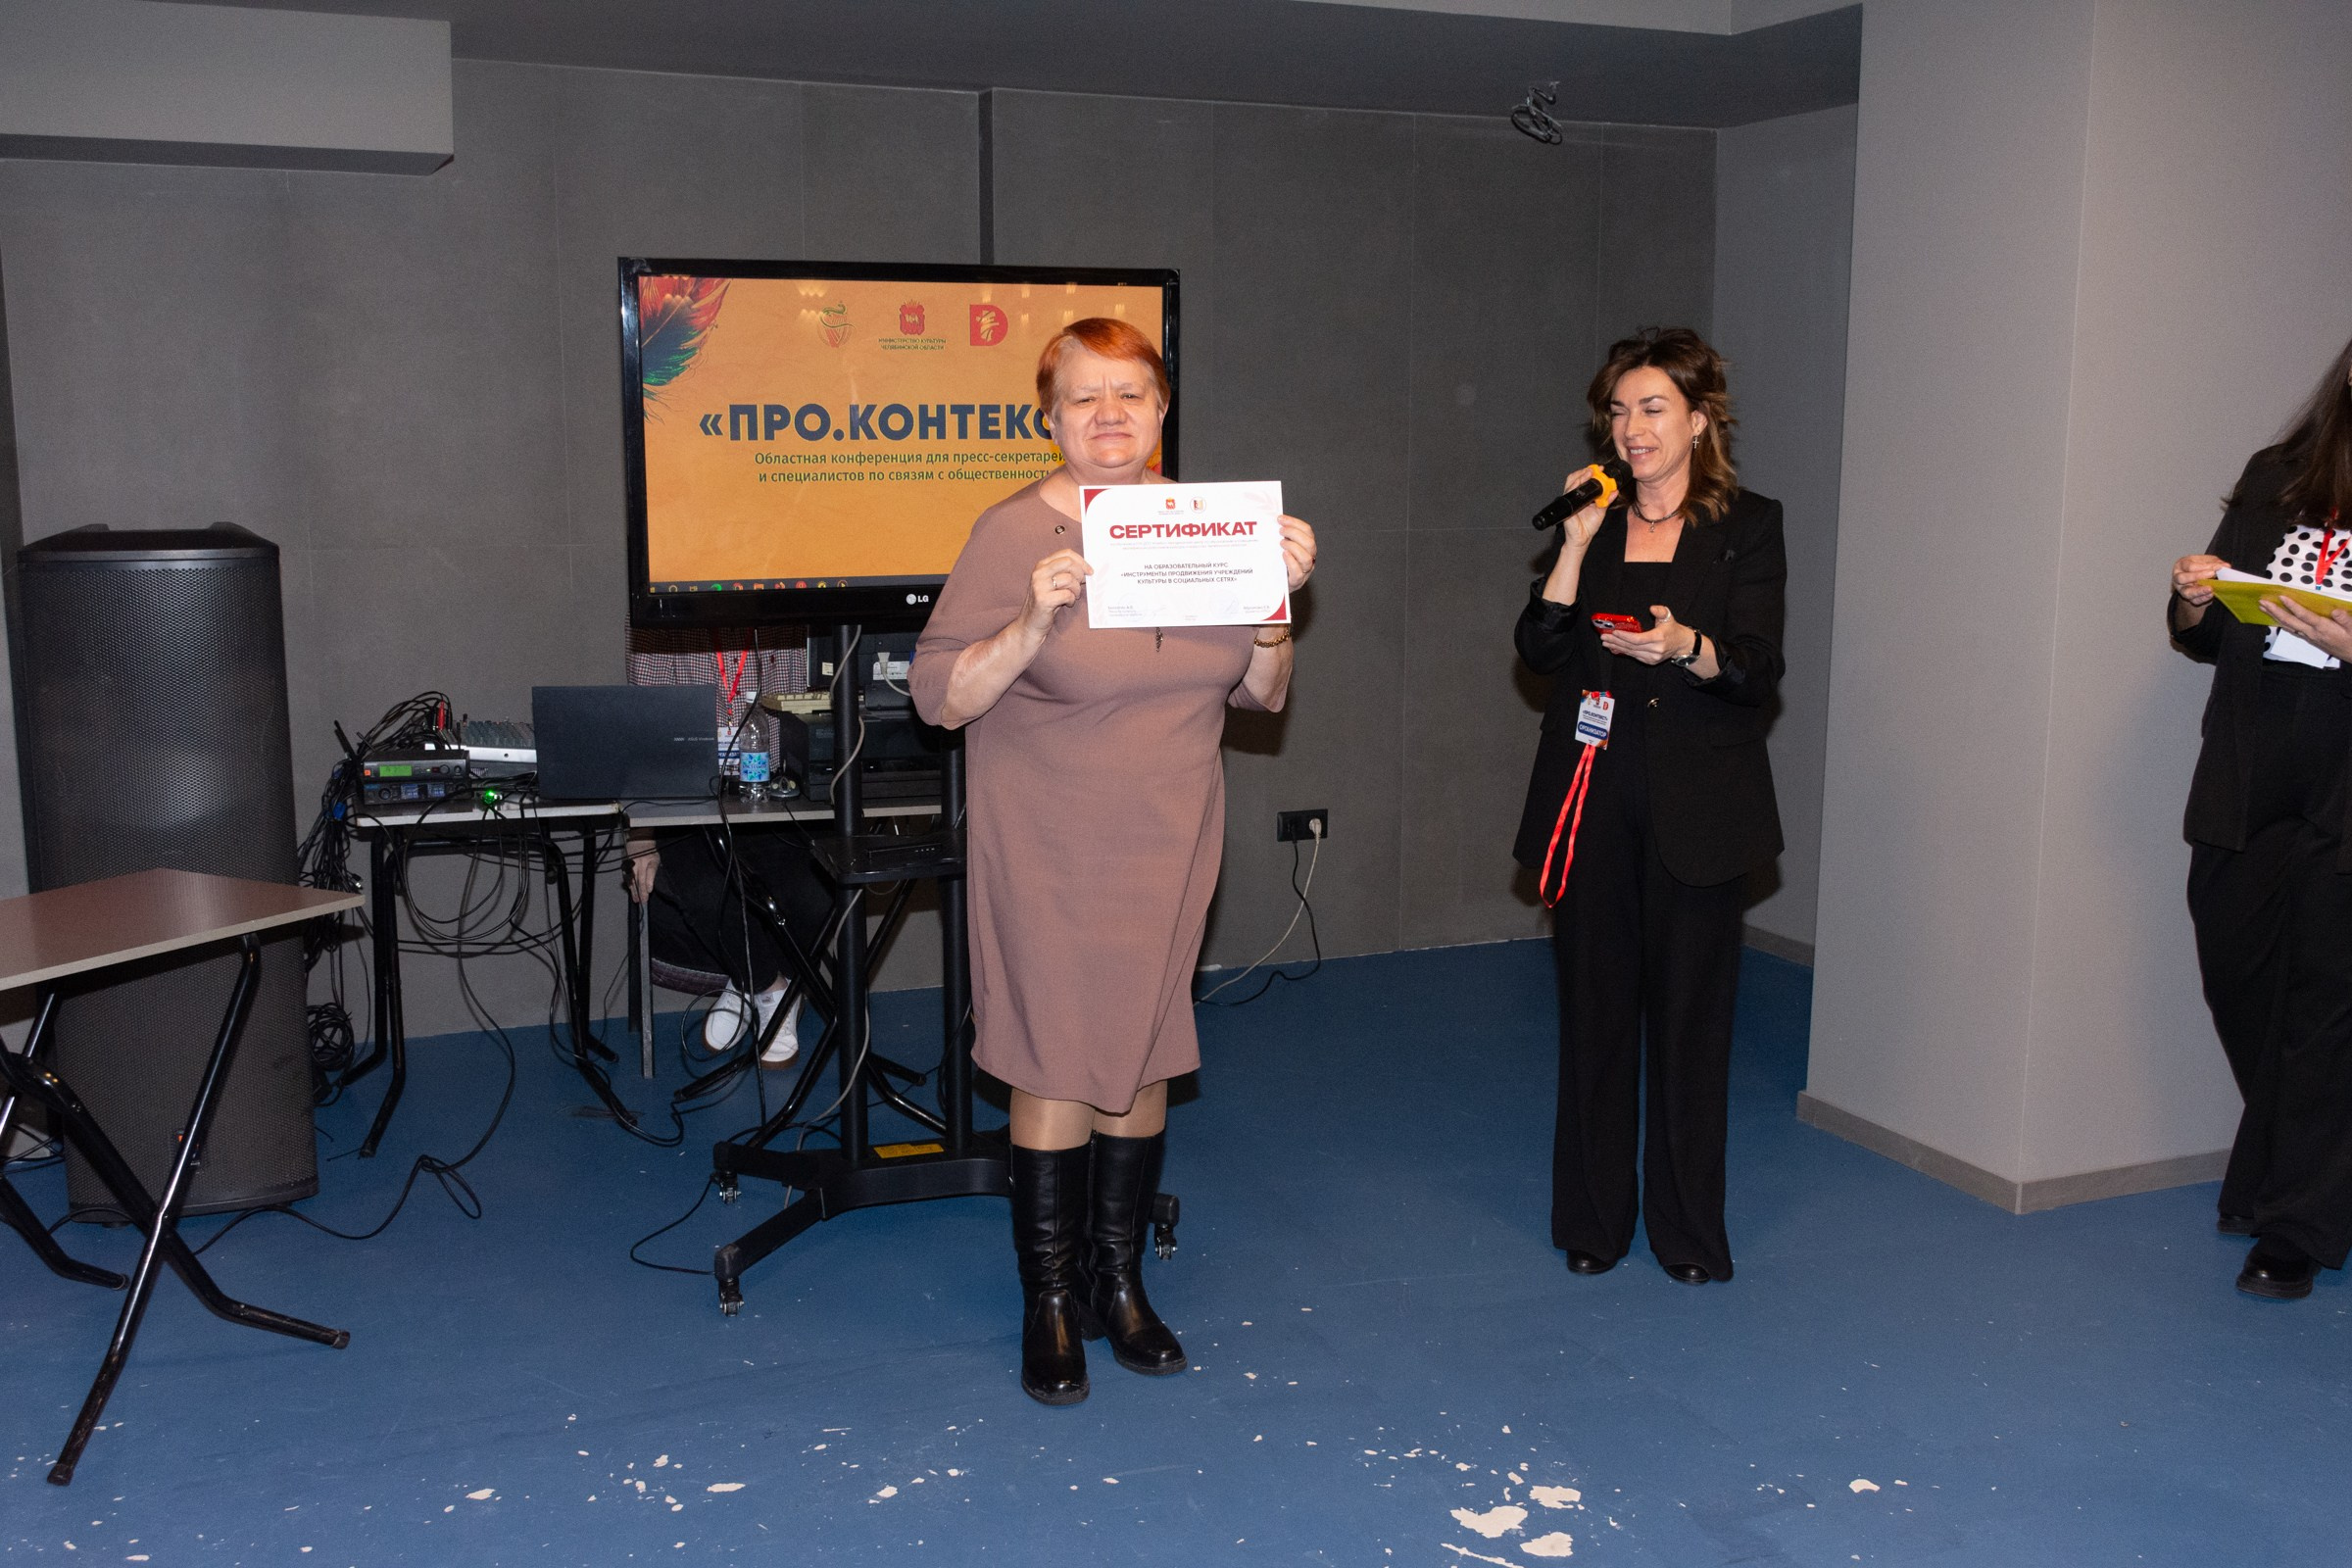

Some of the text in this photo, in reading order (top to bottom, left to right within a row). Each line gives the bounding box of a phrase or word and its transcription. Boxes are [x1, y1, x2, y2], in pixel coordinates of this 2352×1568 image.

[755, 452, 827, 465] Областная
[831, 451, 922, 466] конференция
[926, 453, 949, 465] для
[759, 473, 767, 482] и
[771, 471, 864, 484] специалистов
[868, 471, 885, 481] по
[888, 470, 934, 481] связям
[938, 470, 944, 480] с
[1109, 521, 1257, 539] СЕРТИФИКАТ
[1172, 576, 1215, 585] СОЦИАЛЬНЫХ
